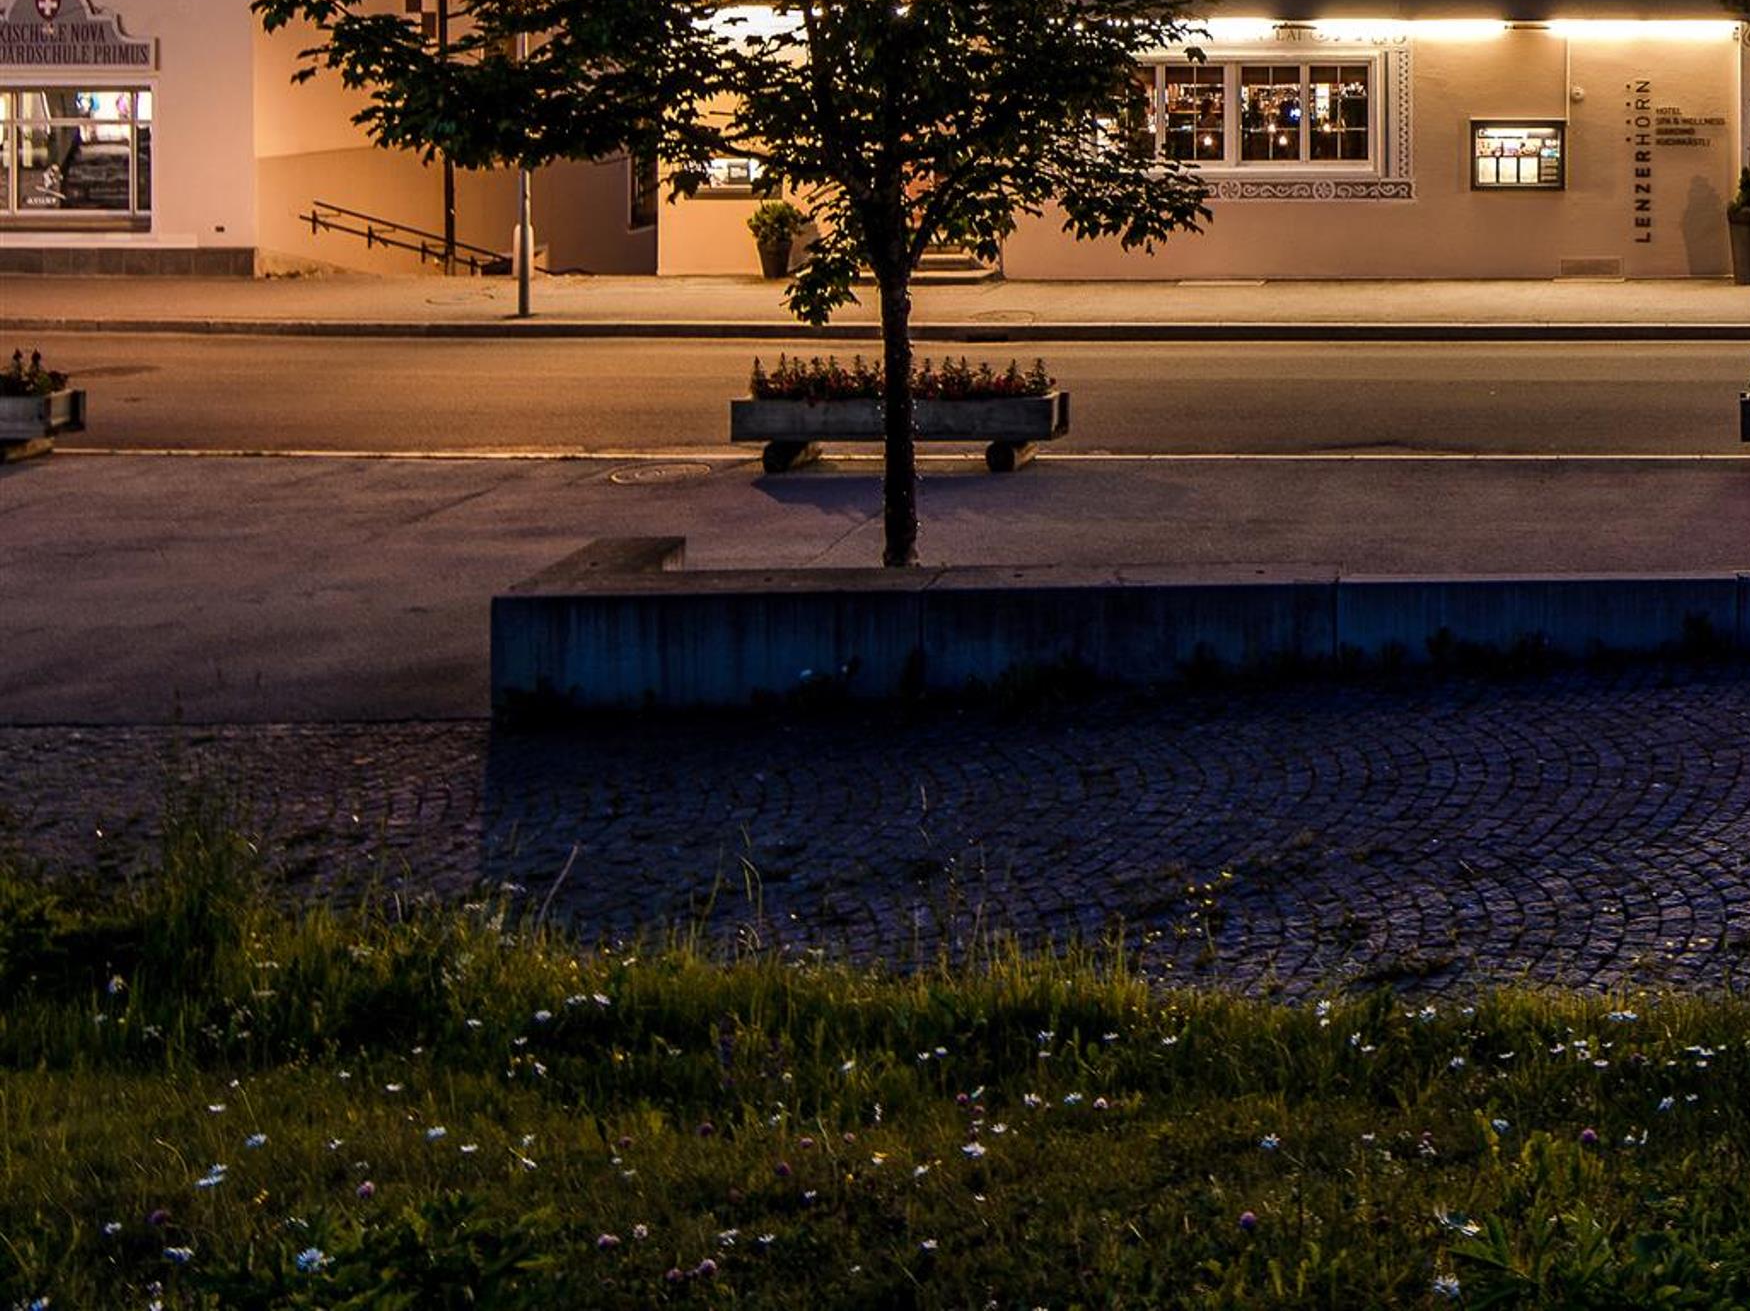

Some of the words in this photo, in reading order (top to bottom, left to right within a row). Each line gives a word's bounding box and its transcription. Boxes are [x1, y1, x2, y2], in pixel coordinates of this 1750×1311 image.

[70, 23, 106, 42] NOVA
[93, 44, 150, 65] PRIMUS
[1656, 106, 1683, 116] HOTEL
[1635, 80, 1652, 243] LENZERHORN
